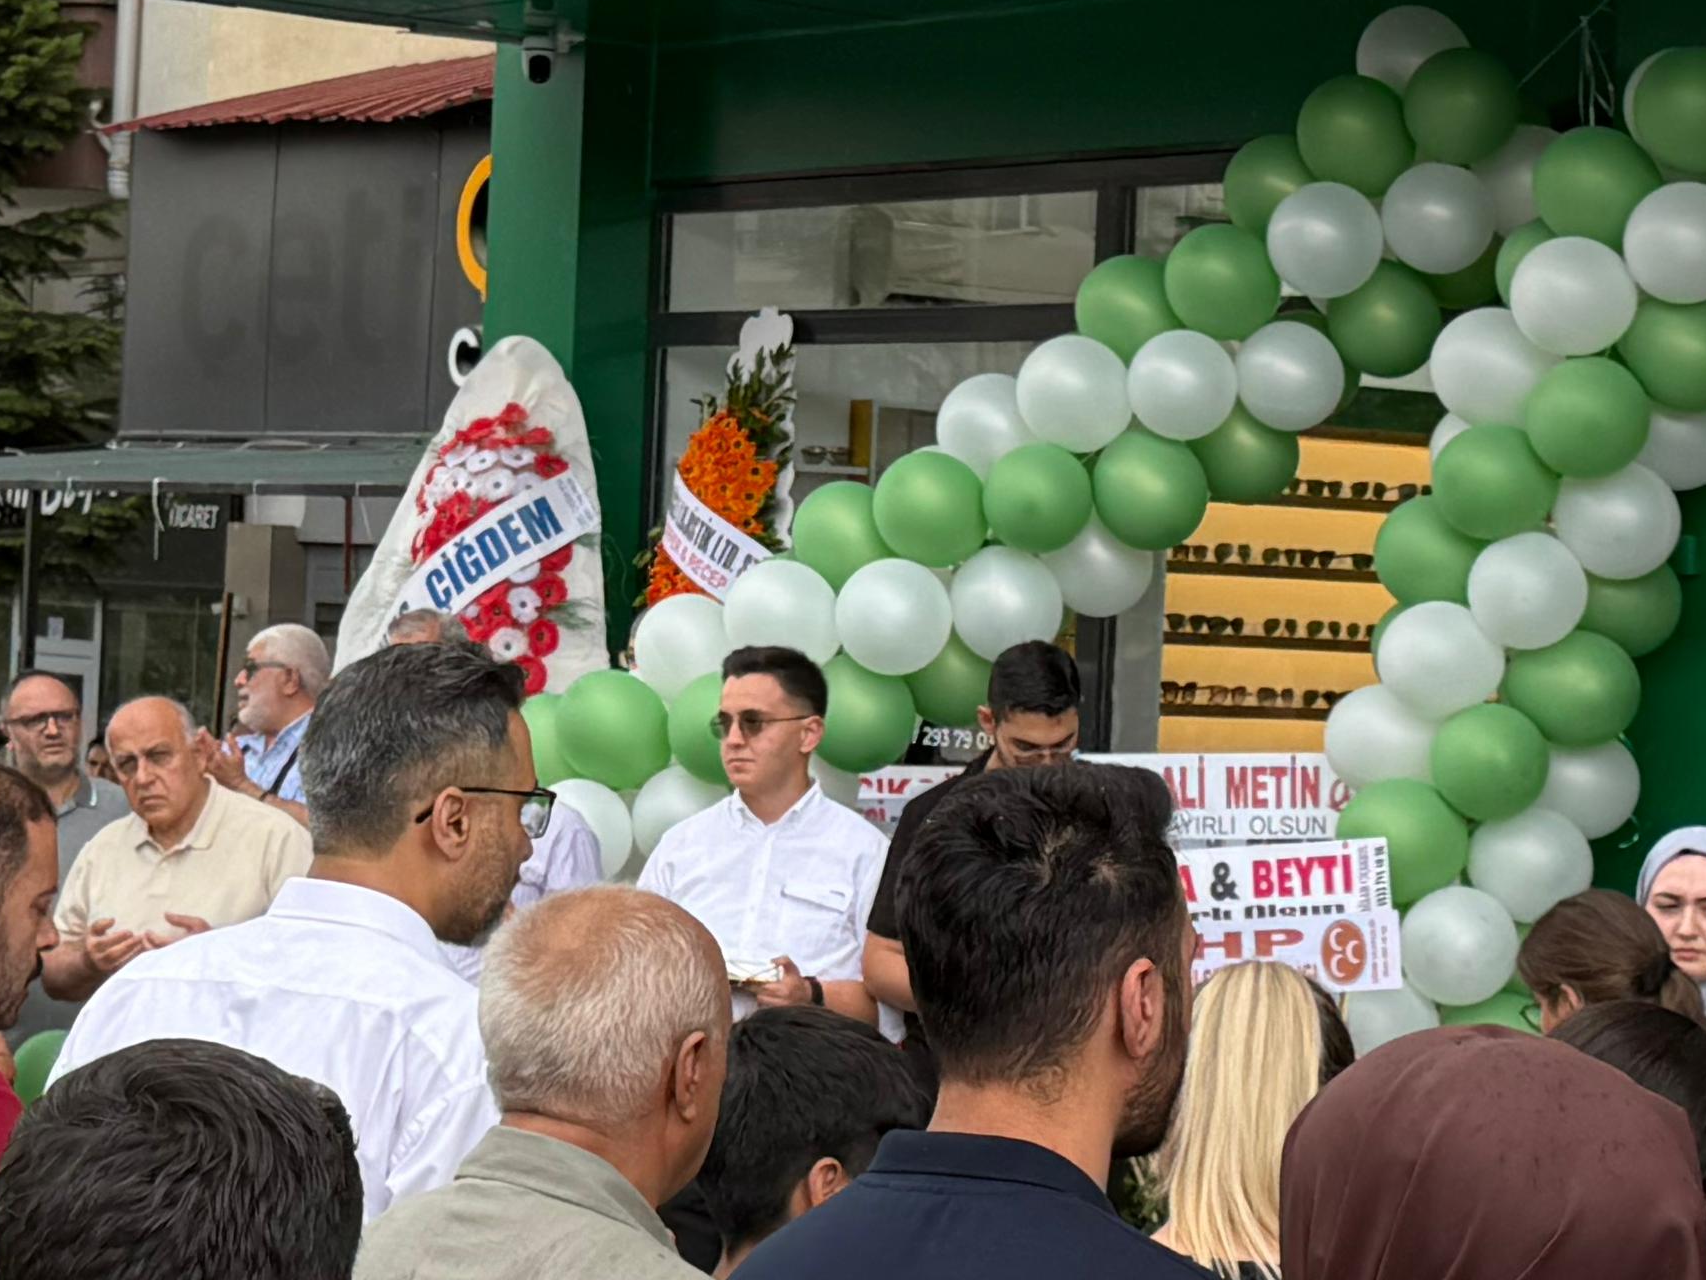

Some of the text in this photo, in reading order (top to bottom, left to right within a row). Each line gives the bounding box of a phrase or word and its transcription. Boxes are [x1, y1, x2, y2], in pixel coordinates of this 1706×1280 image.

[424, 495, 564, 613] ÇİĞDEM
[1226, 755, 1321, 810] METİN
[1169, 815, 1327, 836] AYIRLI OLSUN
[1210, 862, 1240, 901] &
[1252, 841, 1354, 898] BEYTİ
[1194, 928, 1304, 960] HP
